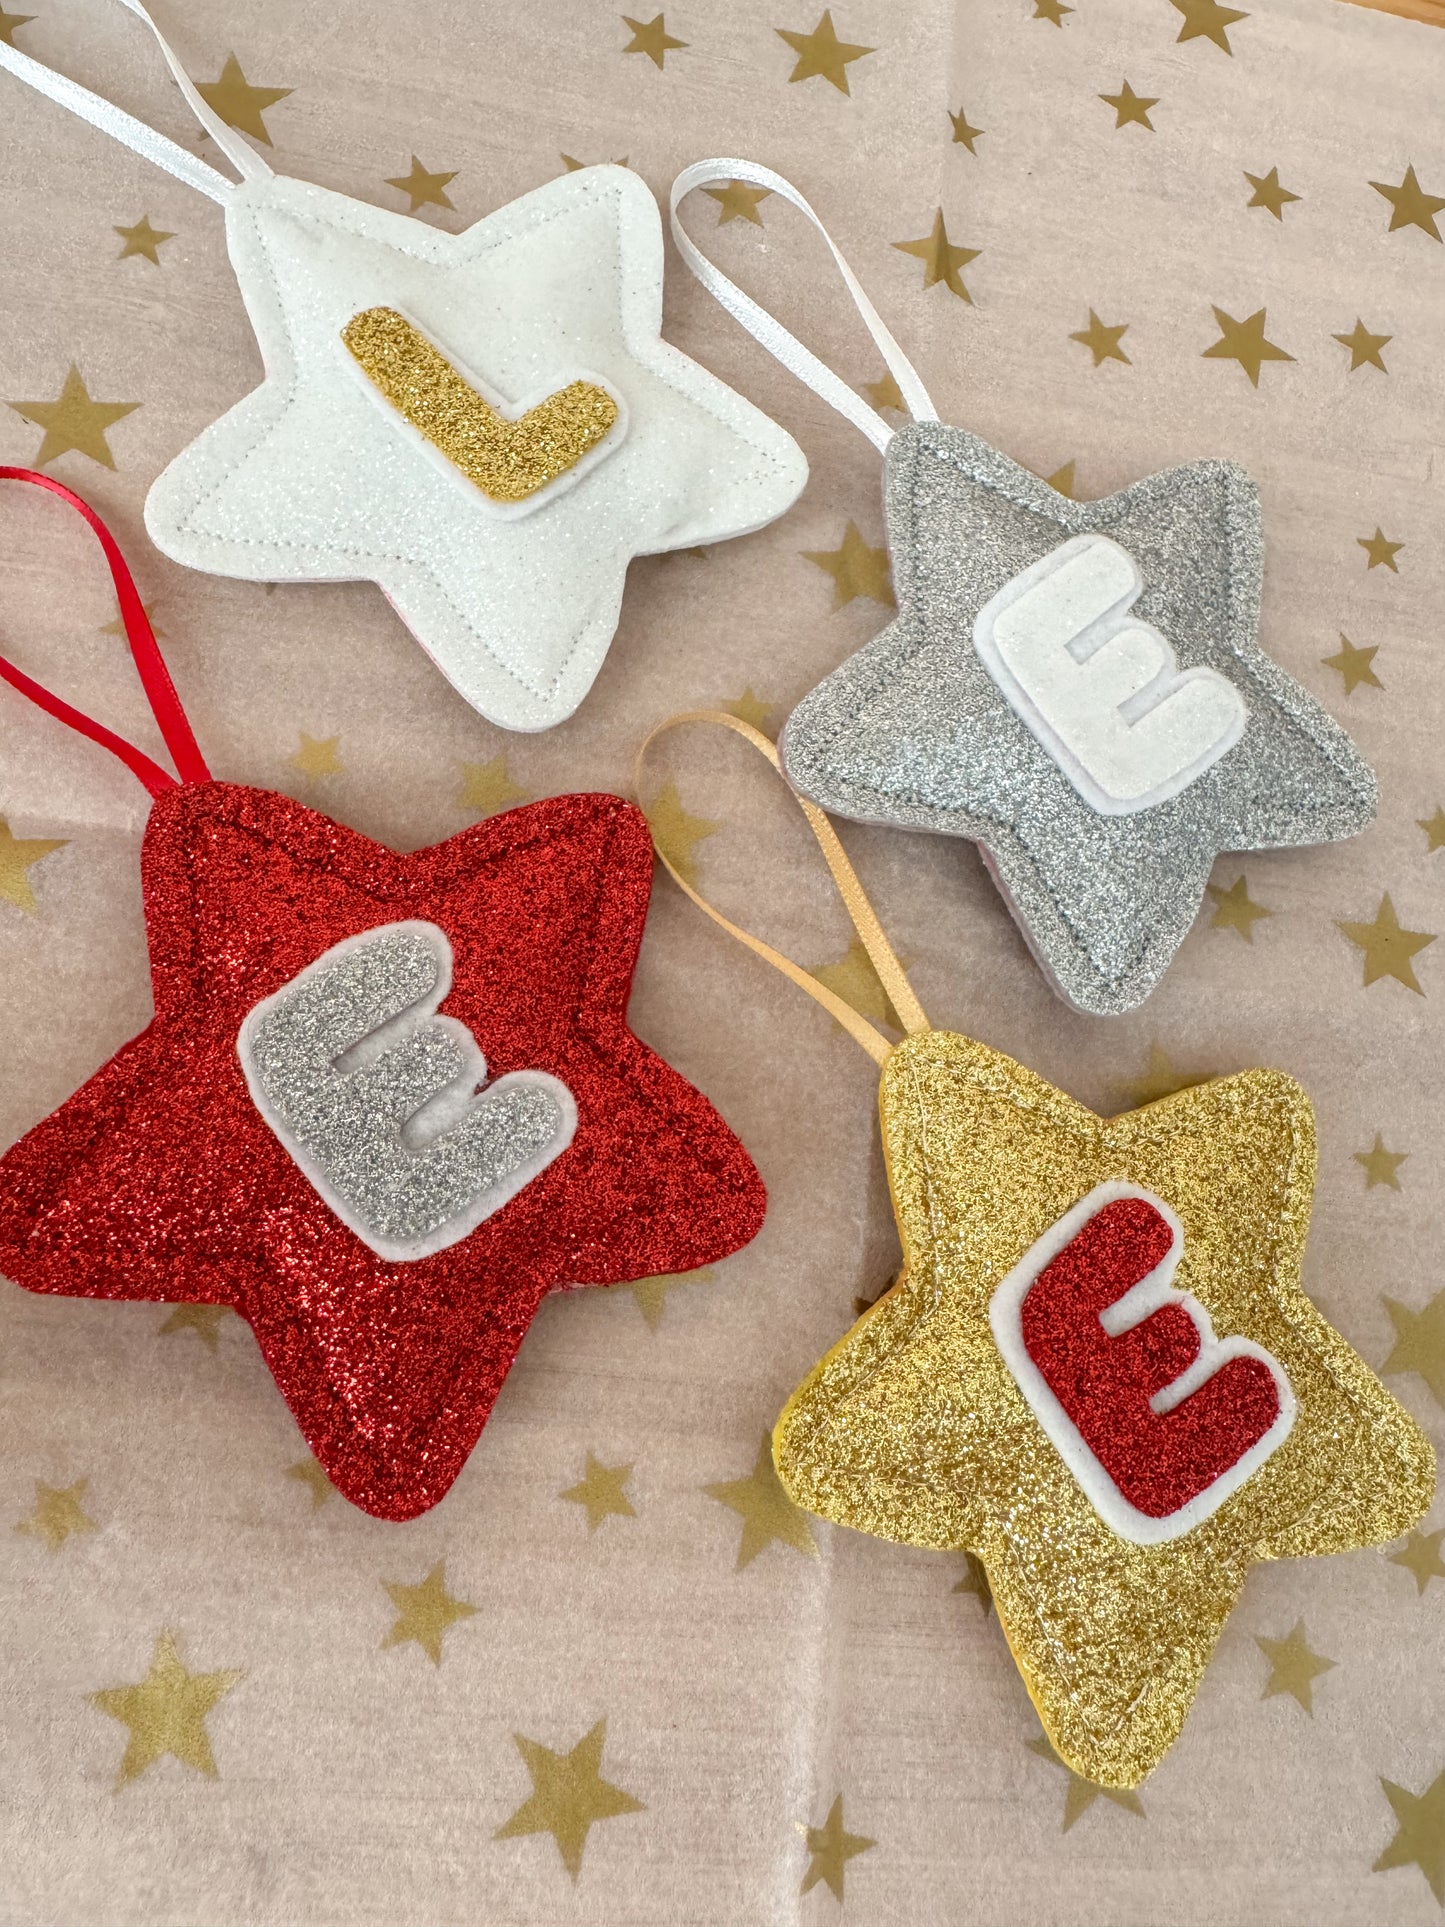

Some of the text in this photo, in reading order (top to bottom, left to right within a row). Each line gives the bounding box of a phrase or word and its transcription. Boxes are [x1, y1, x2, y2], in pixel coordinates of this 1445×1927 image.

[340, 306, 618, 503] L
[992, 541, 1238, 800] E
[250, 932, 563, 1240] E
[1020, 1197, 1280, 1519] E
